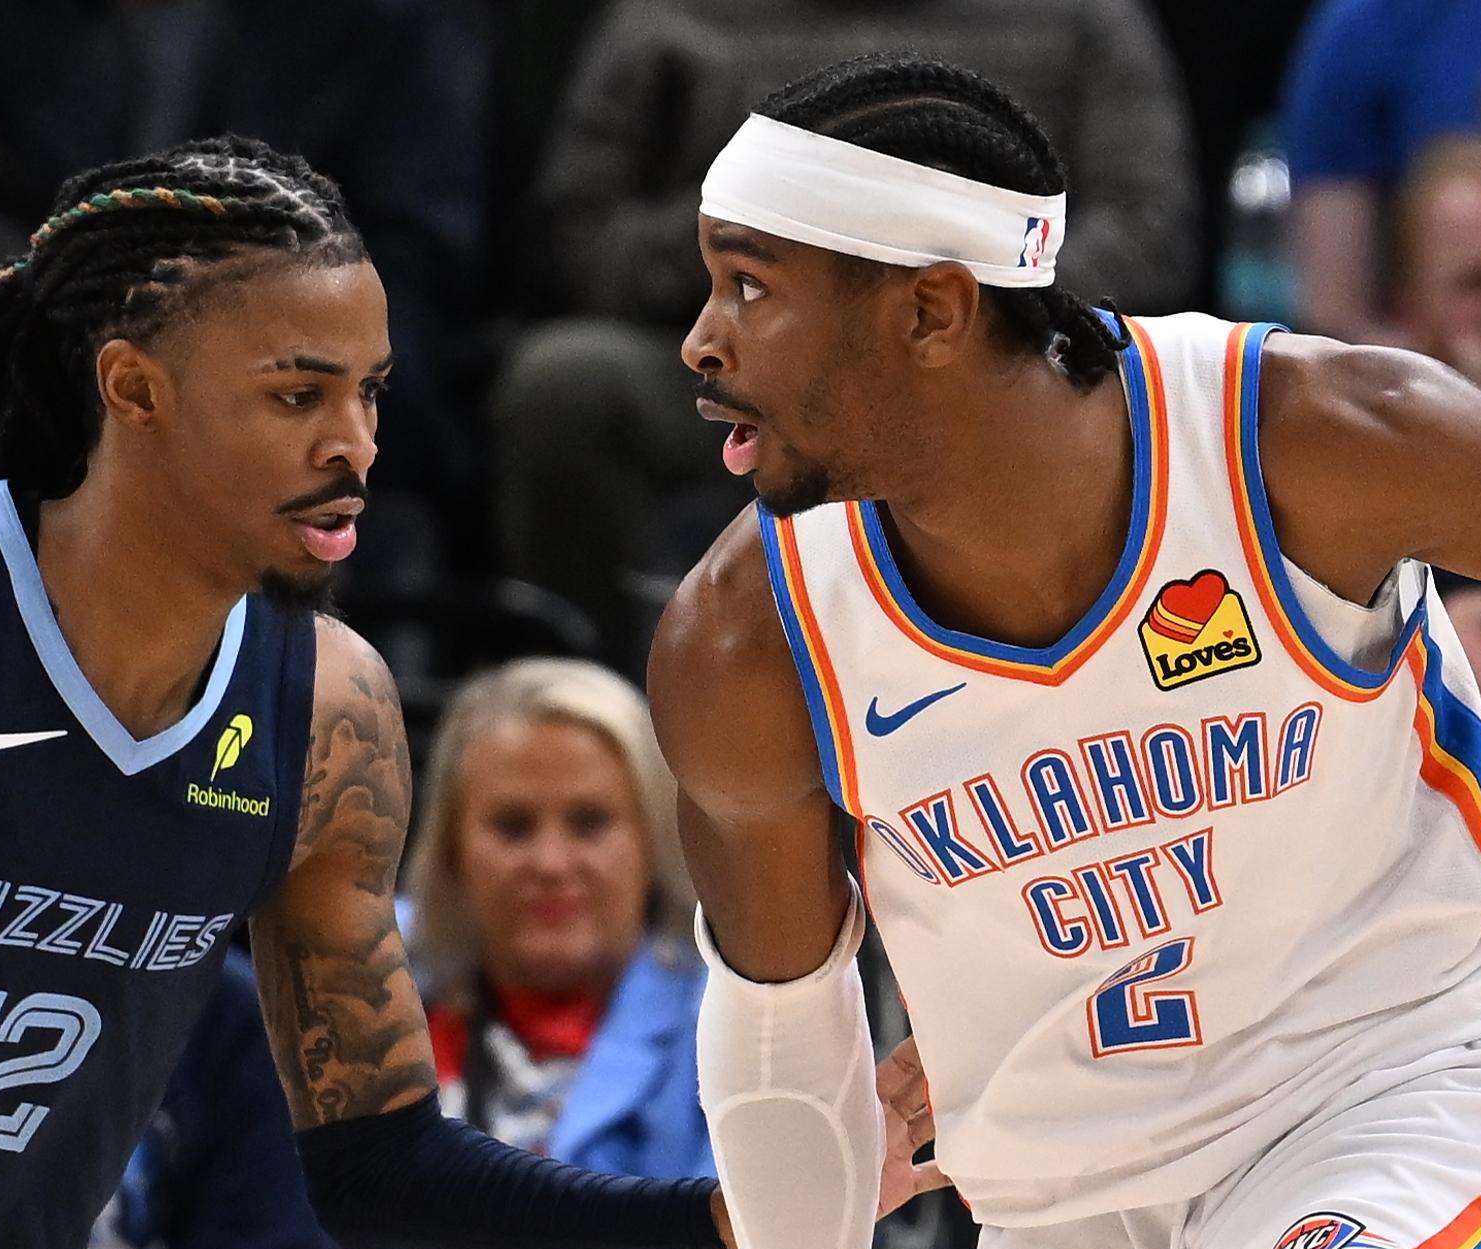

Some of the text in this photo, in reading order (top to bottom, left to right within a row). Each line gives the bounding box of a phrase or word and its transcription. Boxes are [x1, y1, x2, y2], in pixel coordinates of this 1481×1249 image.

[187, 783, 270, 816] Robinhood
[864, 701, 1324, 888] OKLAHOMA
[1020, 827, 1225, 958] CITY
[1085, 936, 1204, 1059] 2
